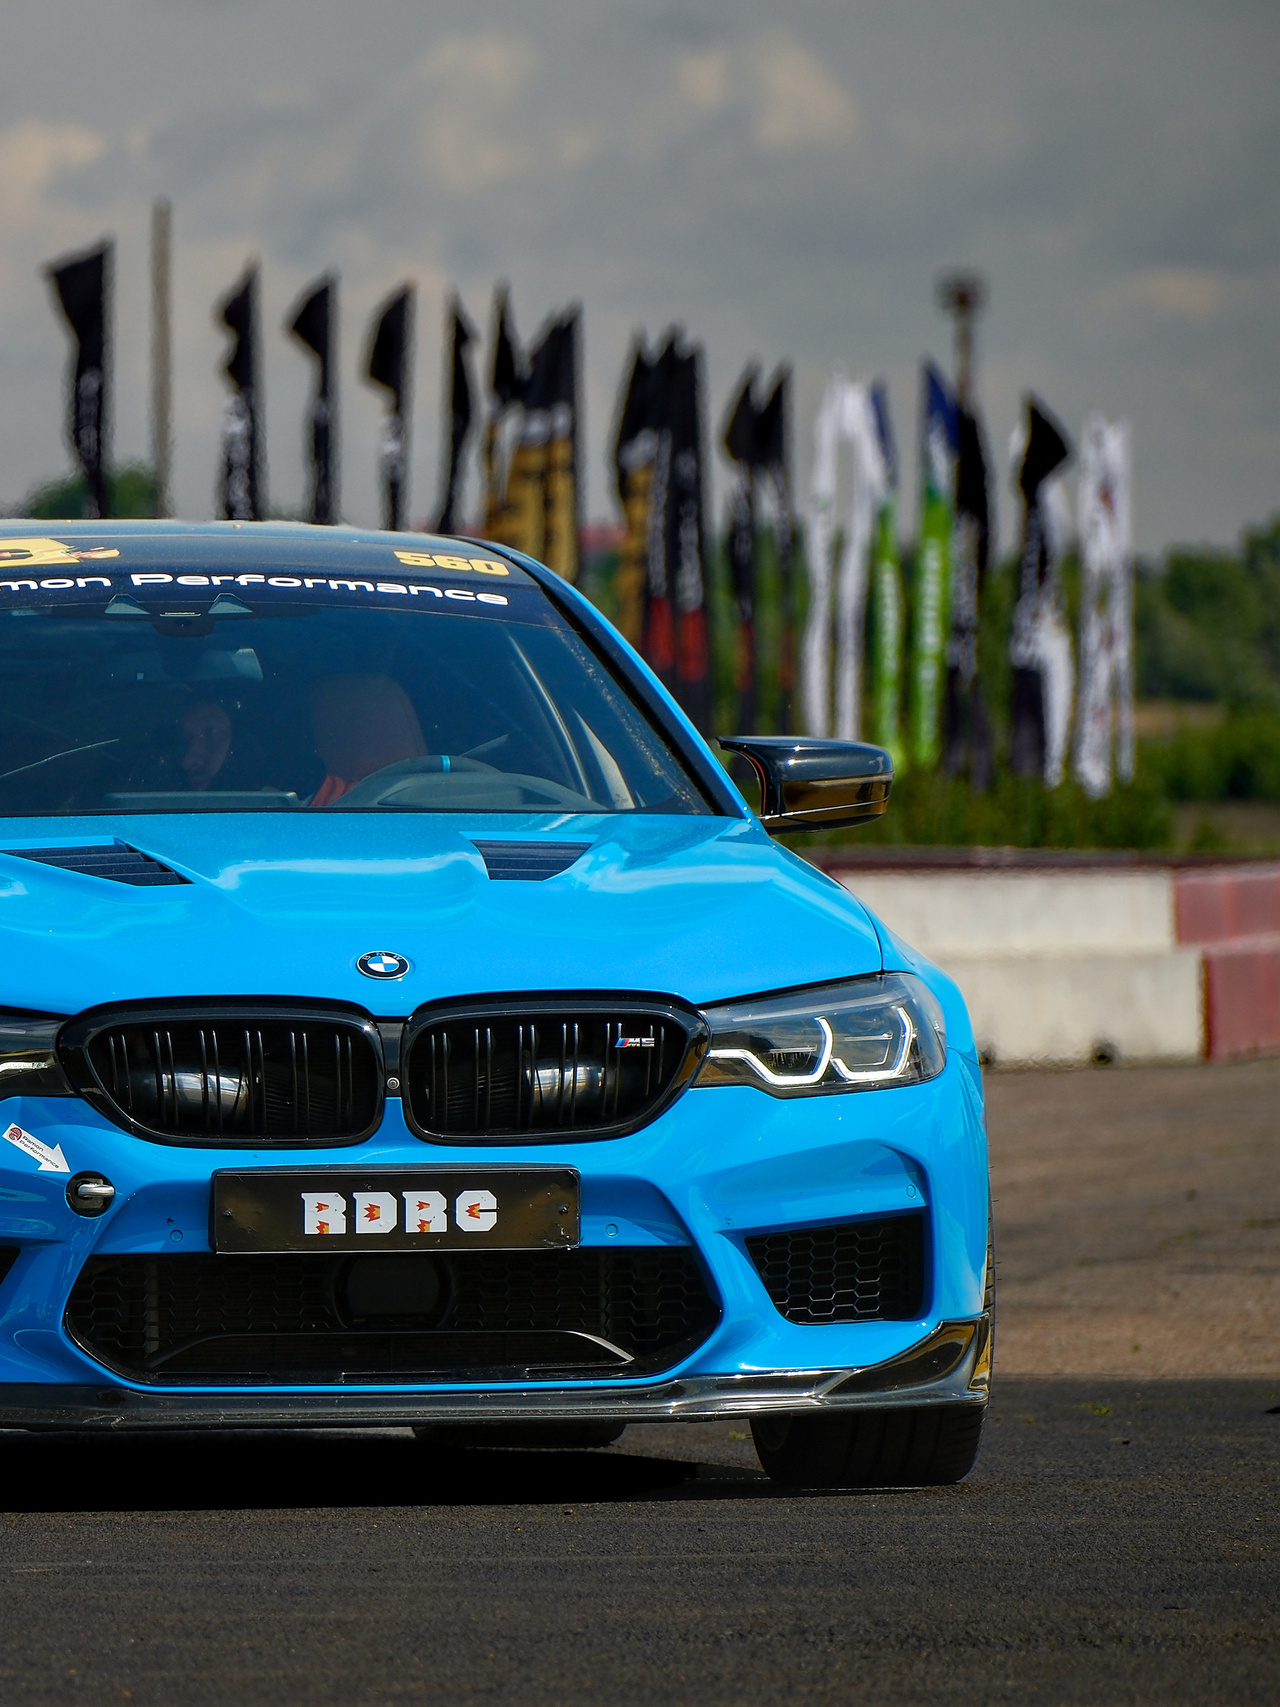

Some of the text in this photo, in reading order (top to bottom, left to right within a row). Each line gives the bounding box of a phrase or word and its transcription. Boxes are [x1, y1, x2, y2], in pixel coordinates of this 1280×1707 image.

[394, 551, 510, 576] 560
[130, 573, 509, 605] Performance
[19, 1139, 59, 1168] Performance
[22, 1135, 43, 1151] Ramon
[301, 1190, 498, 1234] RDRC
